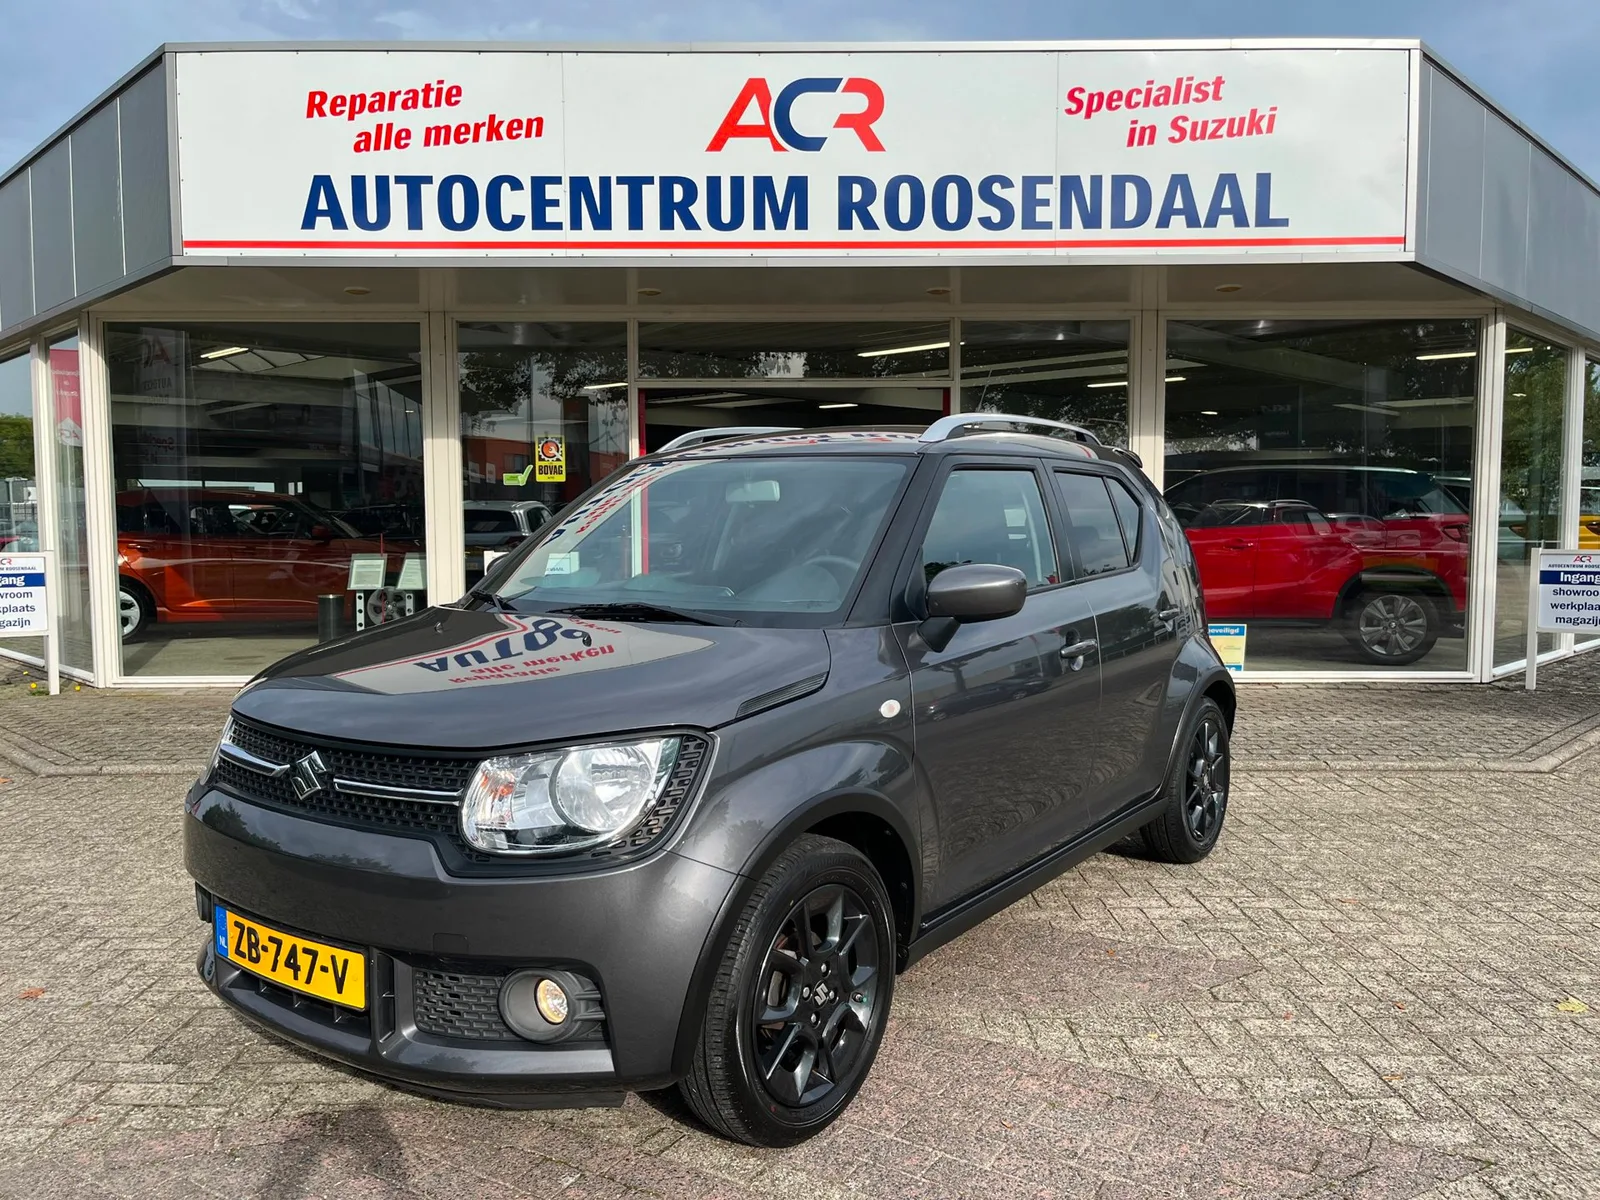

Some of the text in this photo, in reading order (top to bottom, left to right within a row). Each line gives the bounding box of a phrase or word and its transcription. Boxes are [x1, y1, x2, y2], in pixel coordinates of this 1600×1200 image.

[306, 79, 463, 121] Reparatie
[705, 77, 886, 152] ACR
[1064, 75, 1225, 120] Specialist
[353, 113, 545, 153] alle merken
[1126, 106, 1278, 147] in Suzuki
[300, 172, 1289, 232] AUTOCENTRUM ROOSENDAAL
[538, 465, 563, 475] BOVAG
[0, 604, 36, 614] plaats
[1555, 616, 1600, 626] magazij
[219, 934, 228, 949] NL
[233, 920, 349, 995] ZB-747-V
